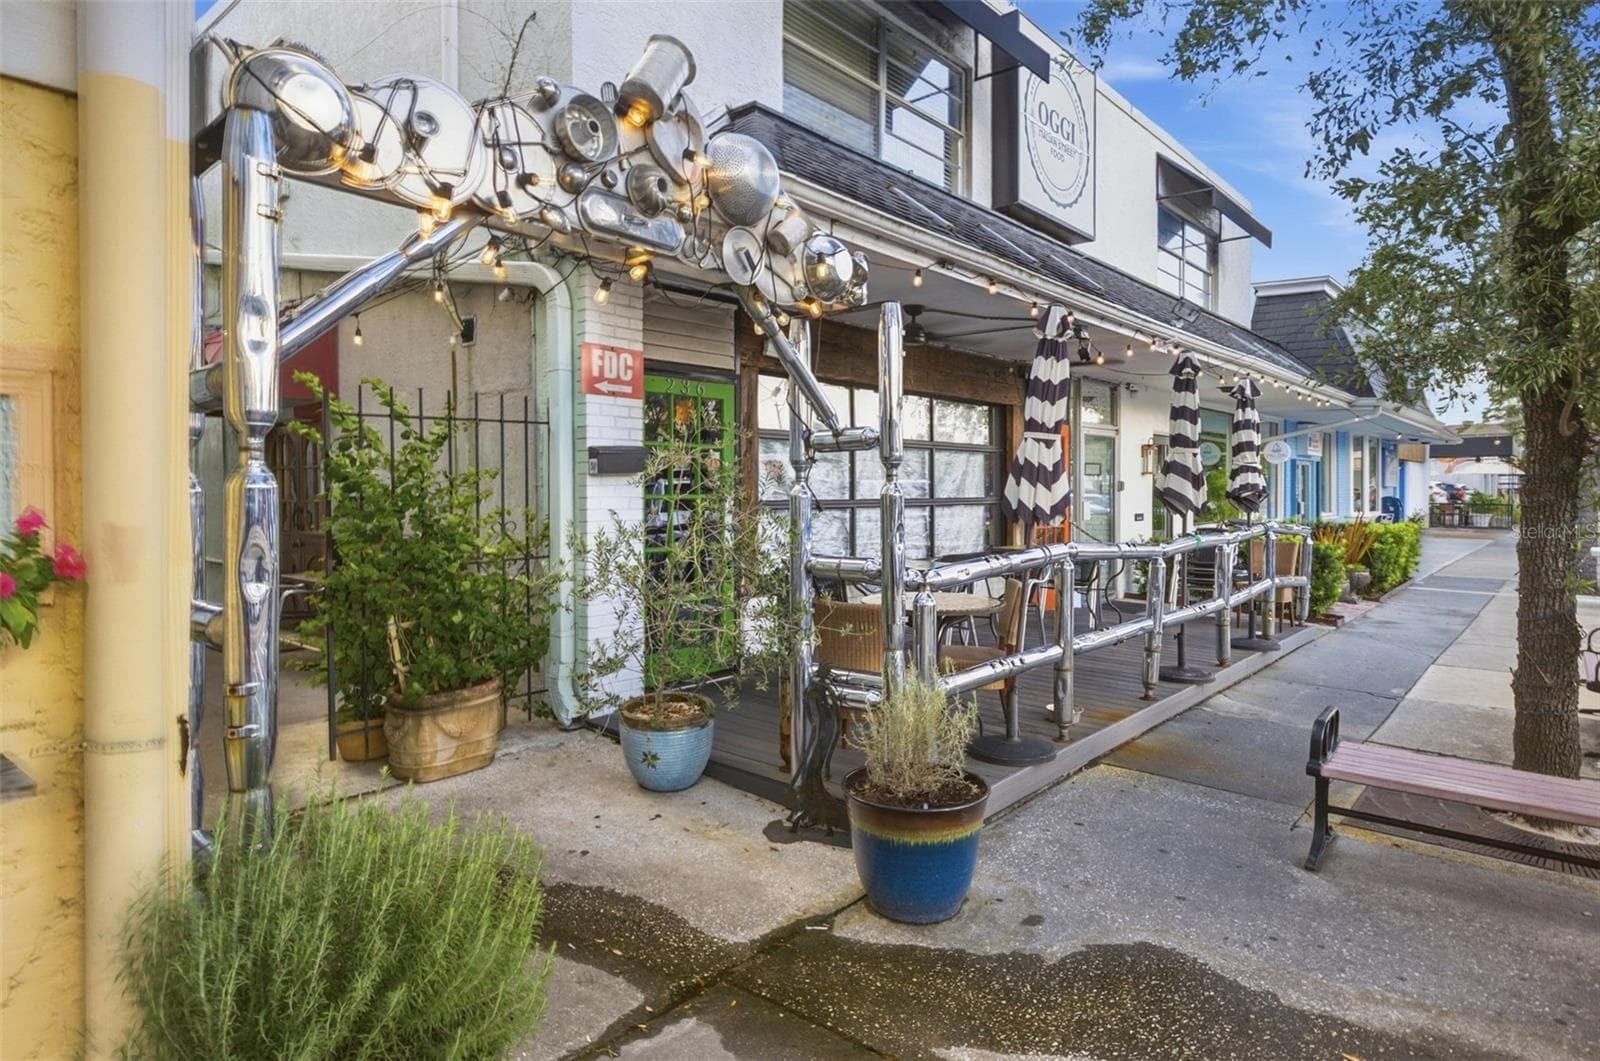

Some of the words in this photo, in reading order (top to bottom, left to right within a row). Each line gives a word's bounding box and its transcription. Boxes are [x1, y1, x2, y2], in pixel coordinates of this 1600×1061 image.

[1038, 101, 1075, 144] OGGI
[1050, 147, 1065, 162] FOOD
[592, 349, 633, 382] FDC
[666, 378, 704, 396] 236
